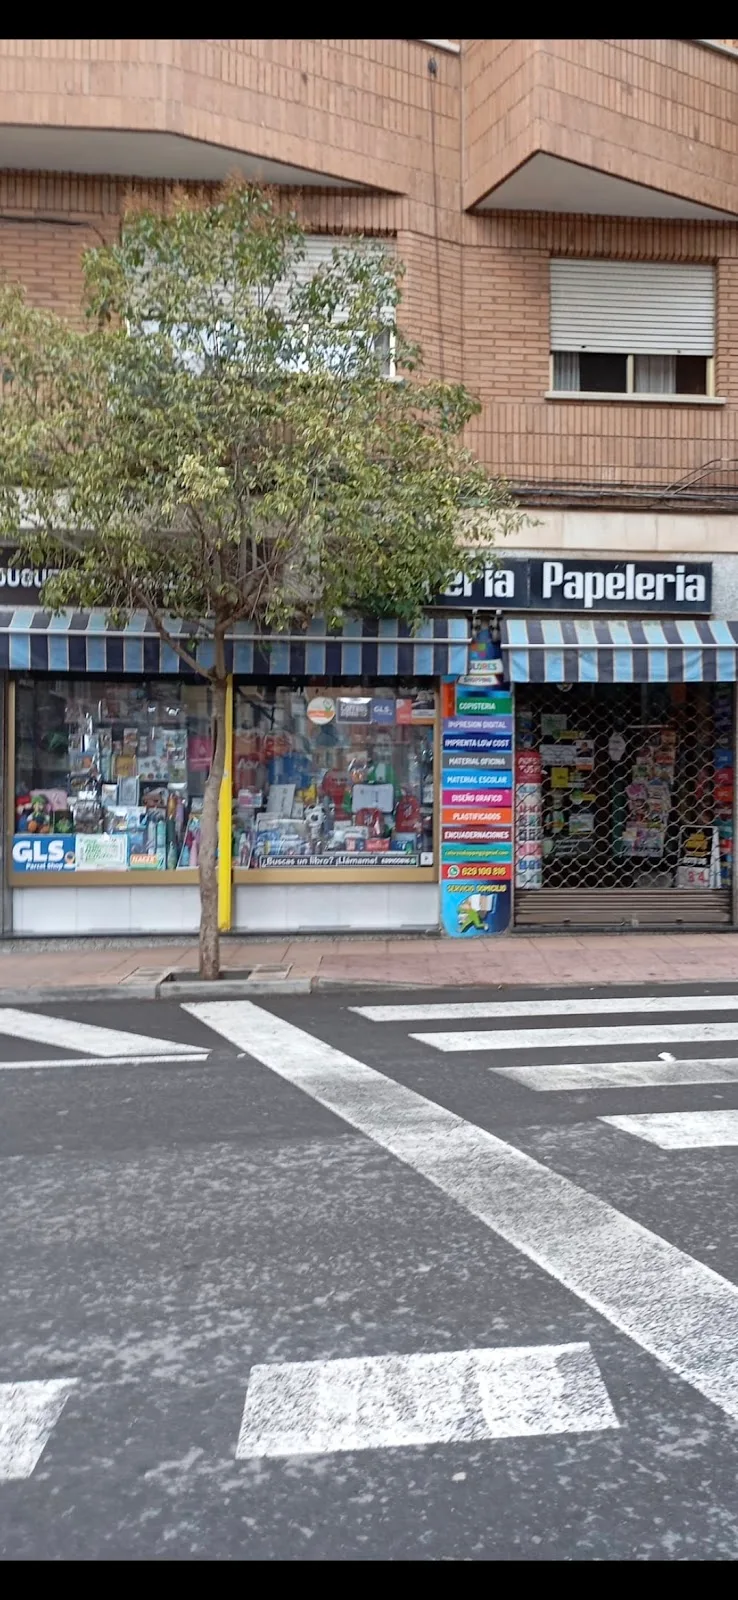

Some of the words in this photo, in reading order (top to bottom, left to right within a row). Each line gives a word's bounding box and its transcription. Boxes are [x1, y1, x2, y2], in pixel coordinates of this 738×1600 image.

[542, 561, 706, 608] Papeleria
[373, 705, 390, 713] GLS
[458, 702, 496, 710] COPISTERIA
[447, 720, 482, 729] IMPRESION
[482, 721, 507, 729] DIGITAL
[444, 739, 477, 747] IMPRENTA
[477, 739, 492, 747] LOW
[492, 739, 510, 748] COST
[448, 757, 480, 766] MATERIAL
[480, 757, 506, 766] OFICINA
[446, 775, 478, 784] MATERIAL
[478, 775, 507, 784] ESCOLAR
[451, 792, 475, 802] DISEÑO
[452, 812, 502, 820] PLASTIFICADOS
[444, 830, 510, 839] ENCUADERNACIONES
[12, 840, 64, 863] GLS
[309, 856, 334, 865] libro?
[47, 863, 64, 871] Shop
